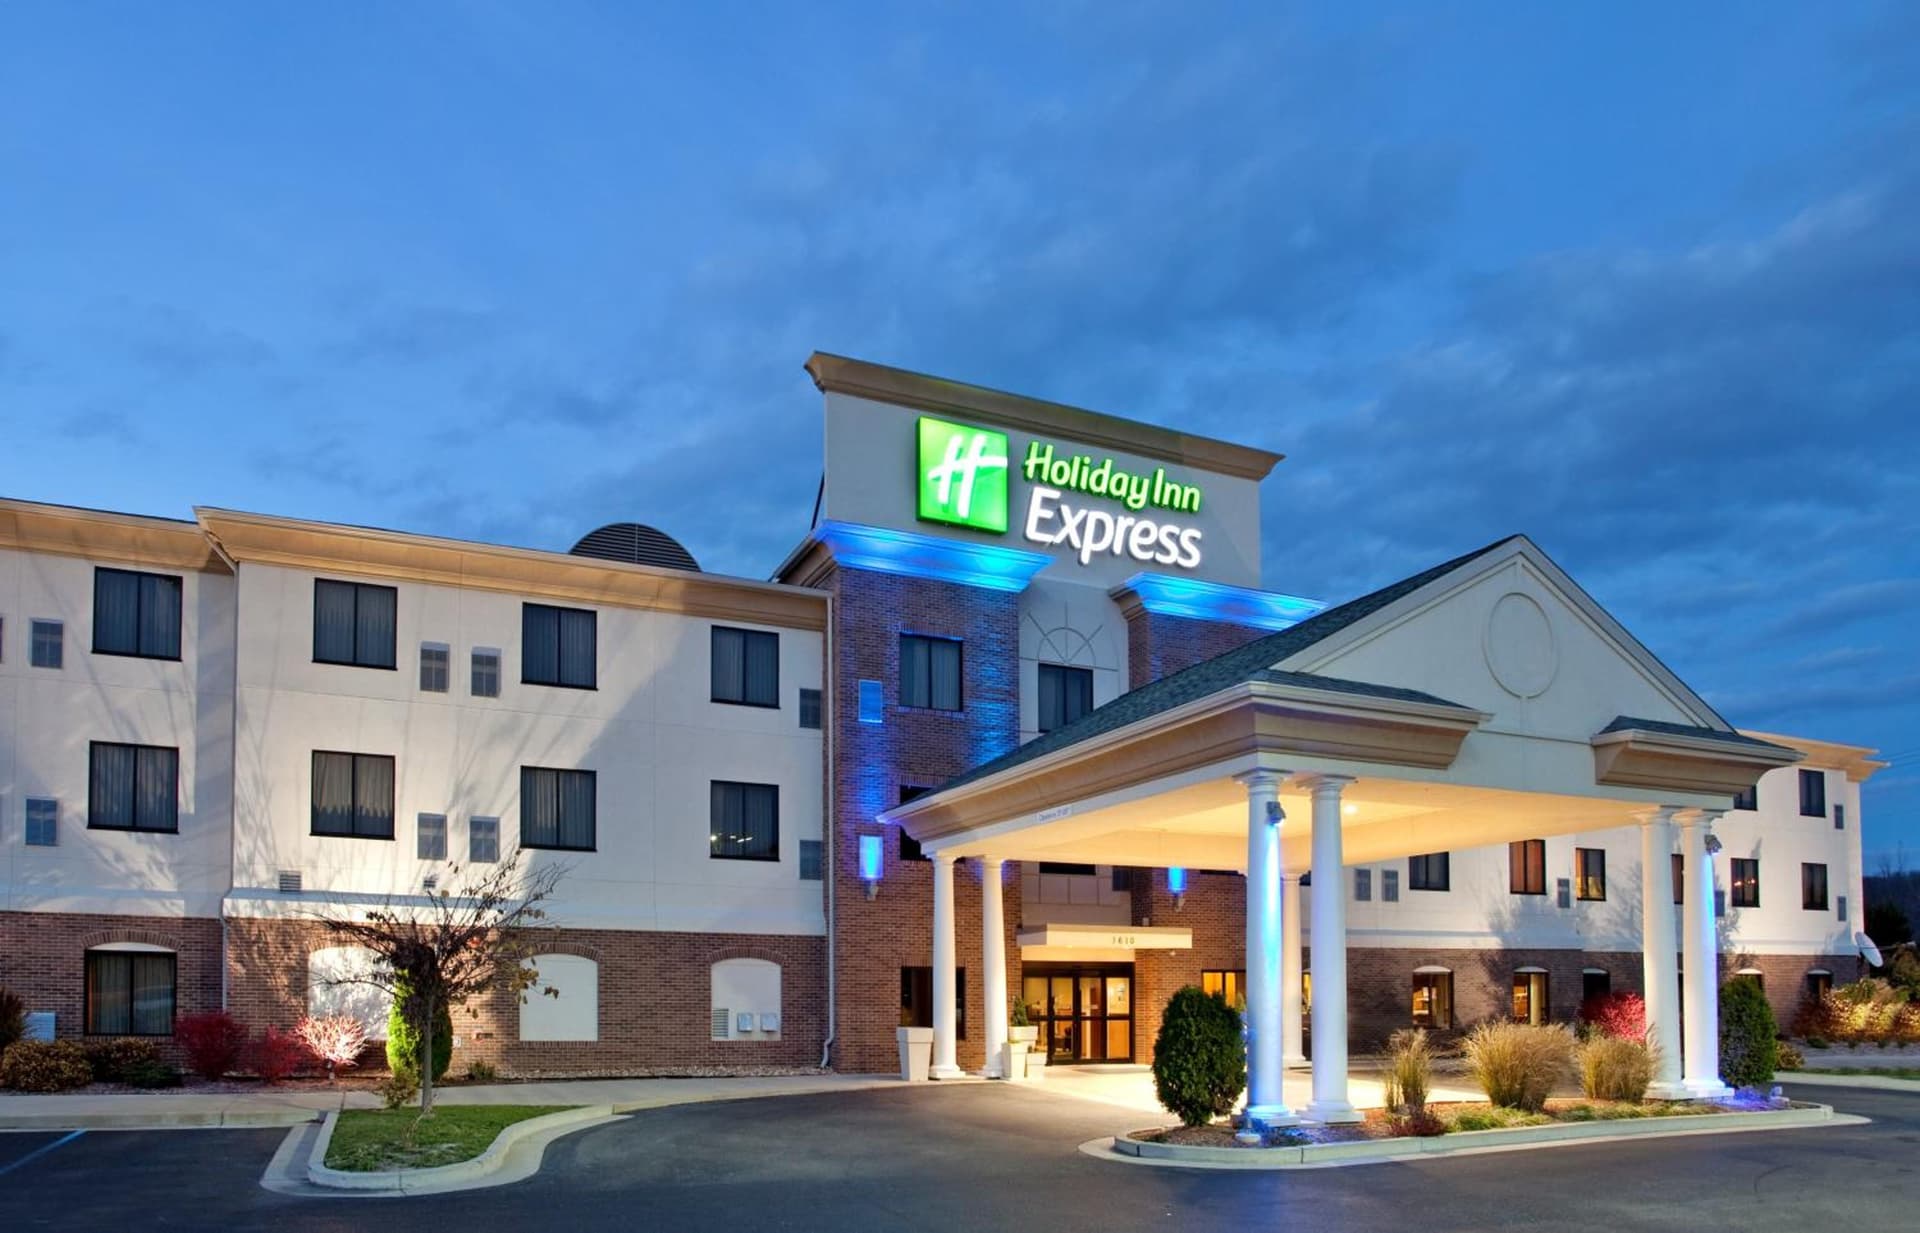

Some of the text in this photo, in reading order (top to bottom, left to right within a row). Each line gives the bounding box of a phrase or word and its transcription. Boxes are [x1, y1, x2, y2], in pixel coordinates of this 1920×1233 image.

[1024, 441, 1201, 513] Holiday Inn
[1025, 486, 1203, 568] Express
